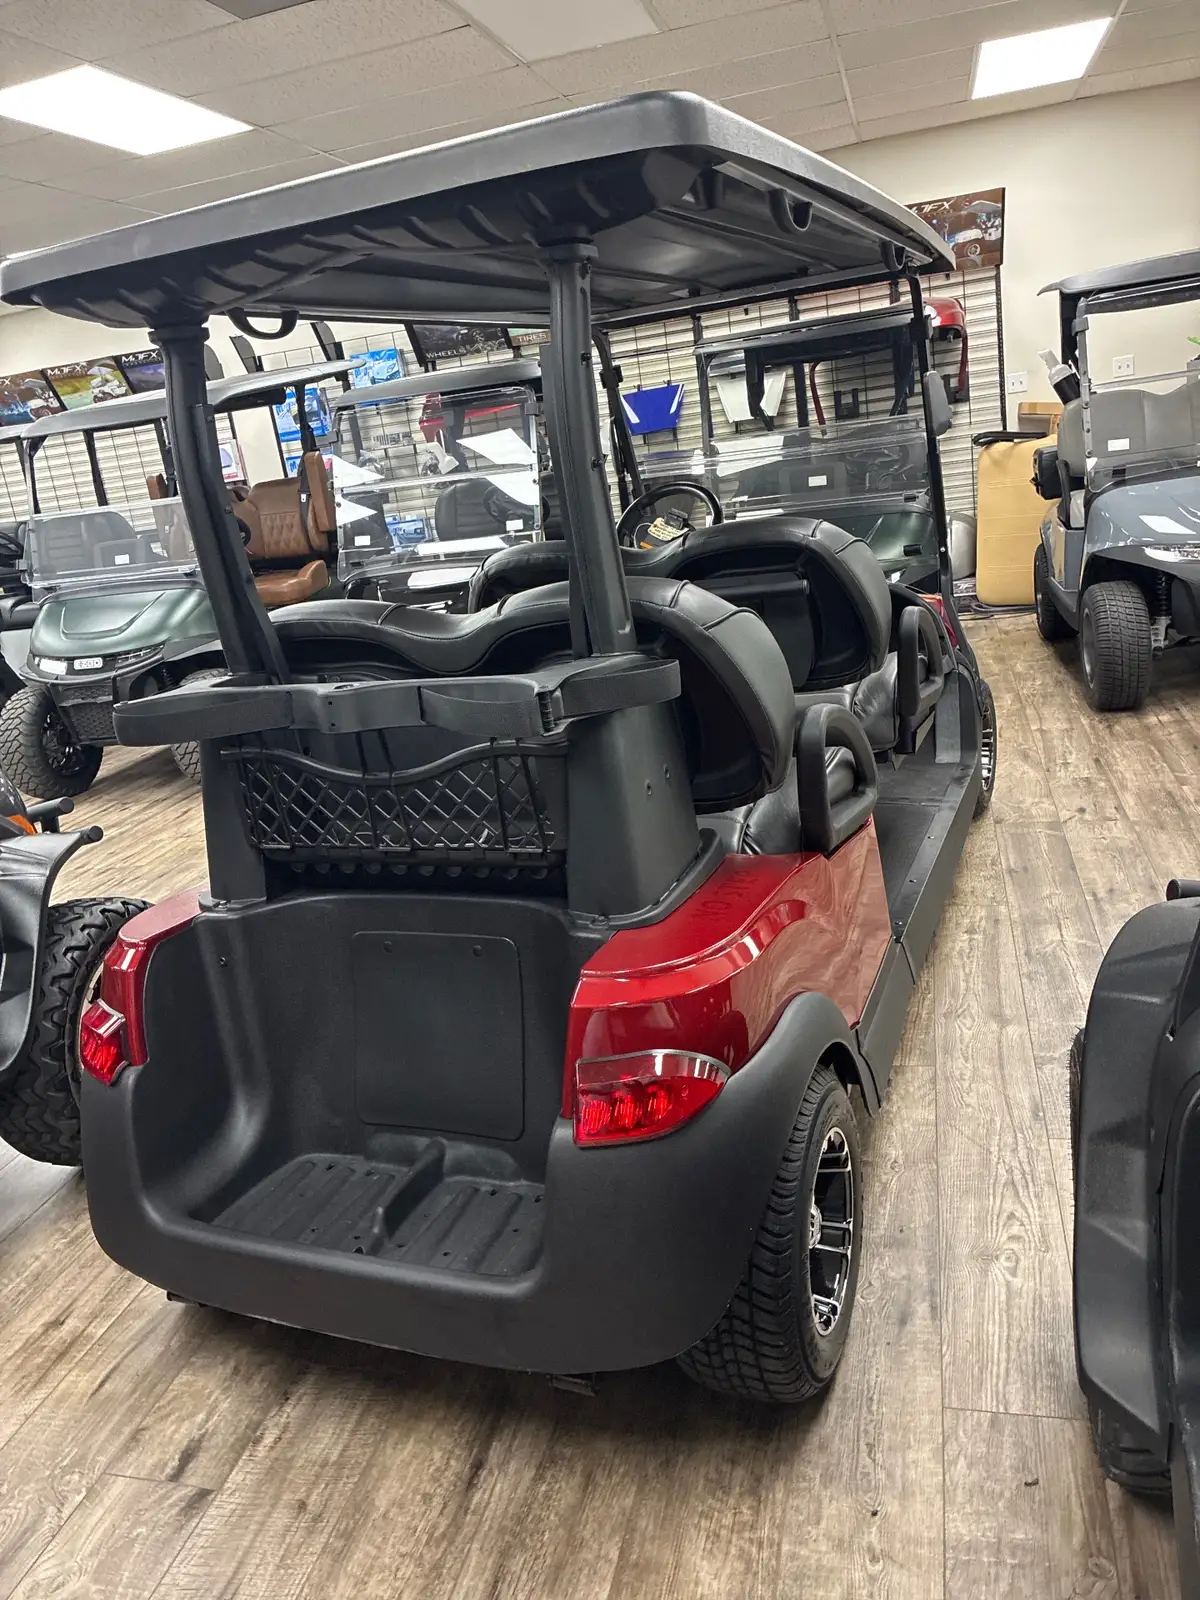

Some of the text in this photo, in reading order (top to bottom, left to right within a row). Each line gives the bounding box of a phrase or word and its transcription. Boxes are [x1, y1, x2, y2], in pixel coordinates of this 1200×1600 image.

[517, 332, 547, 343] TIRES
[121, 350, 159, 364] MJFX
[425, 347, 467, 359] WHEELS
[47, 364, 83, 376] MJFX
